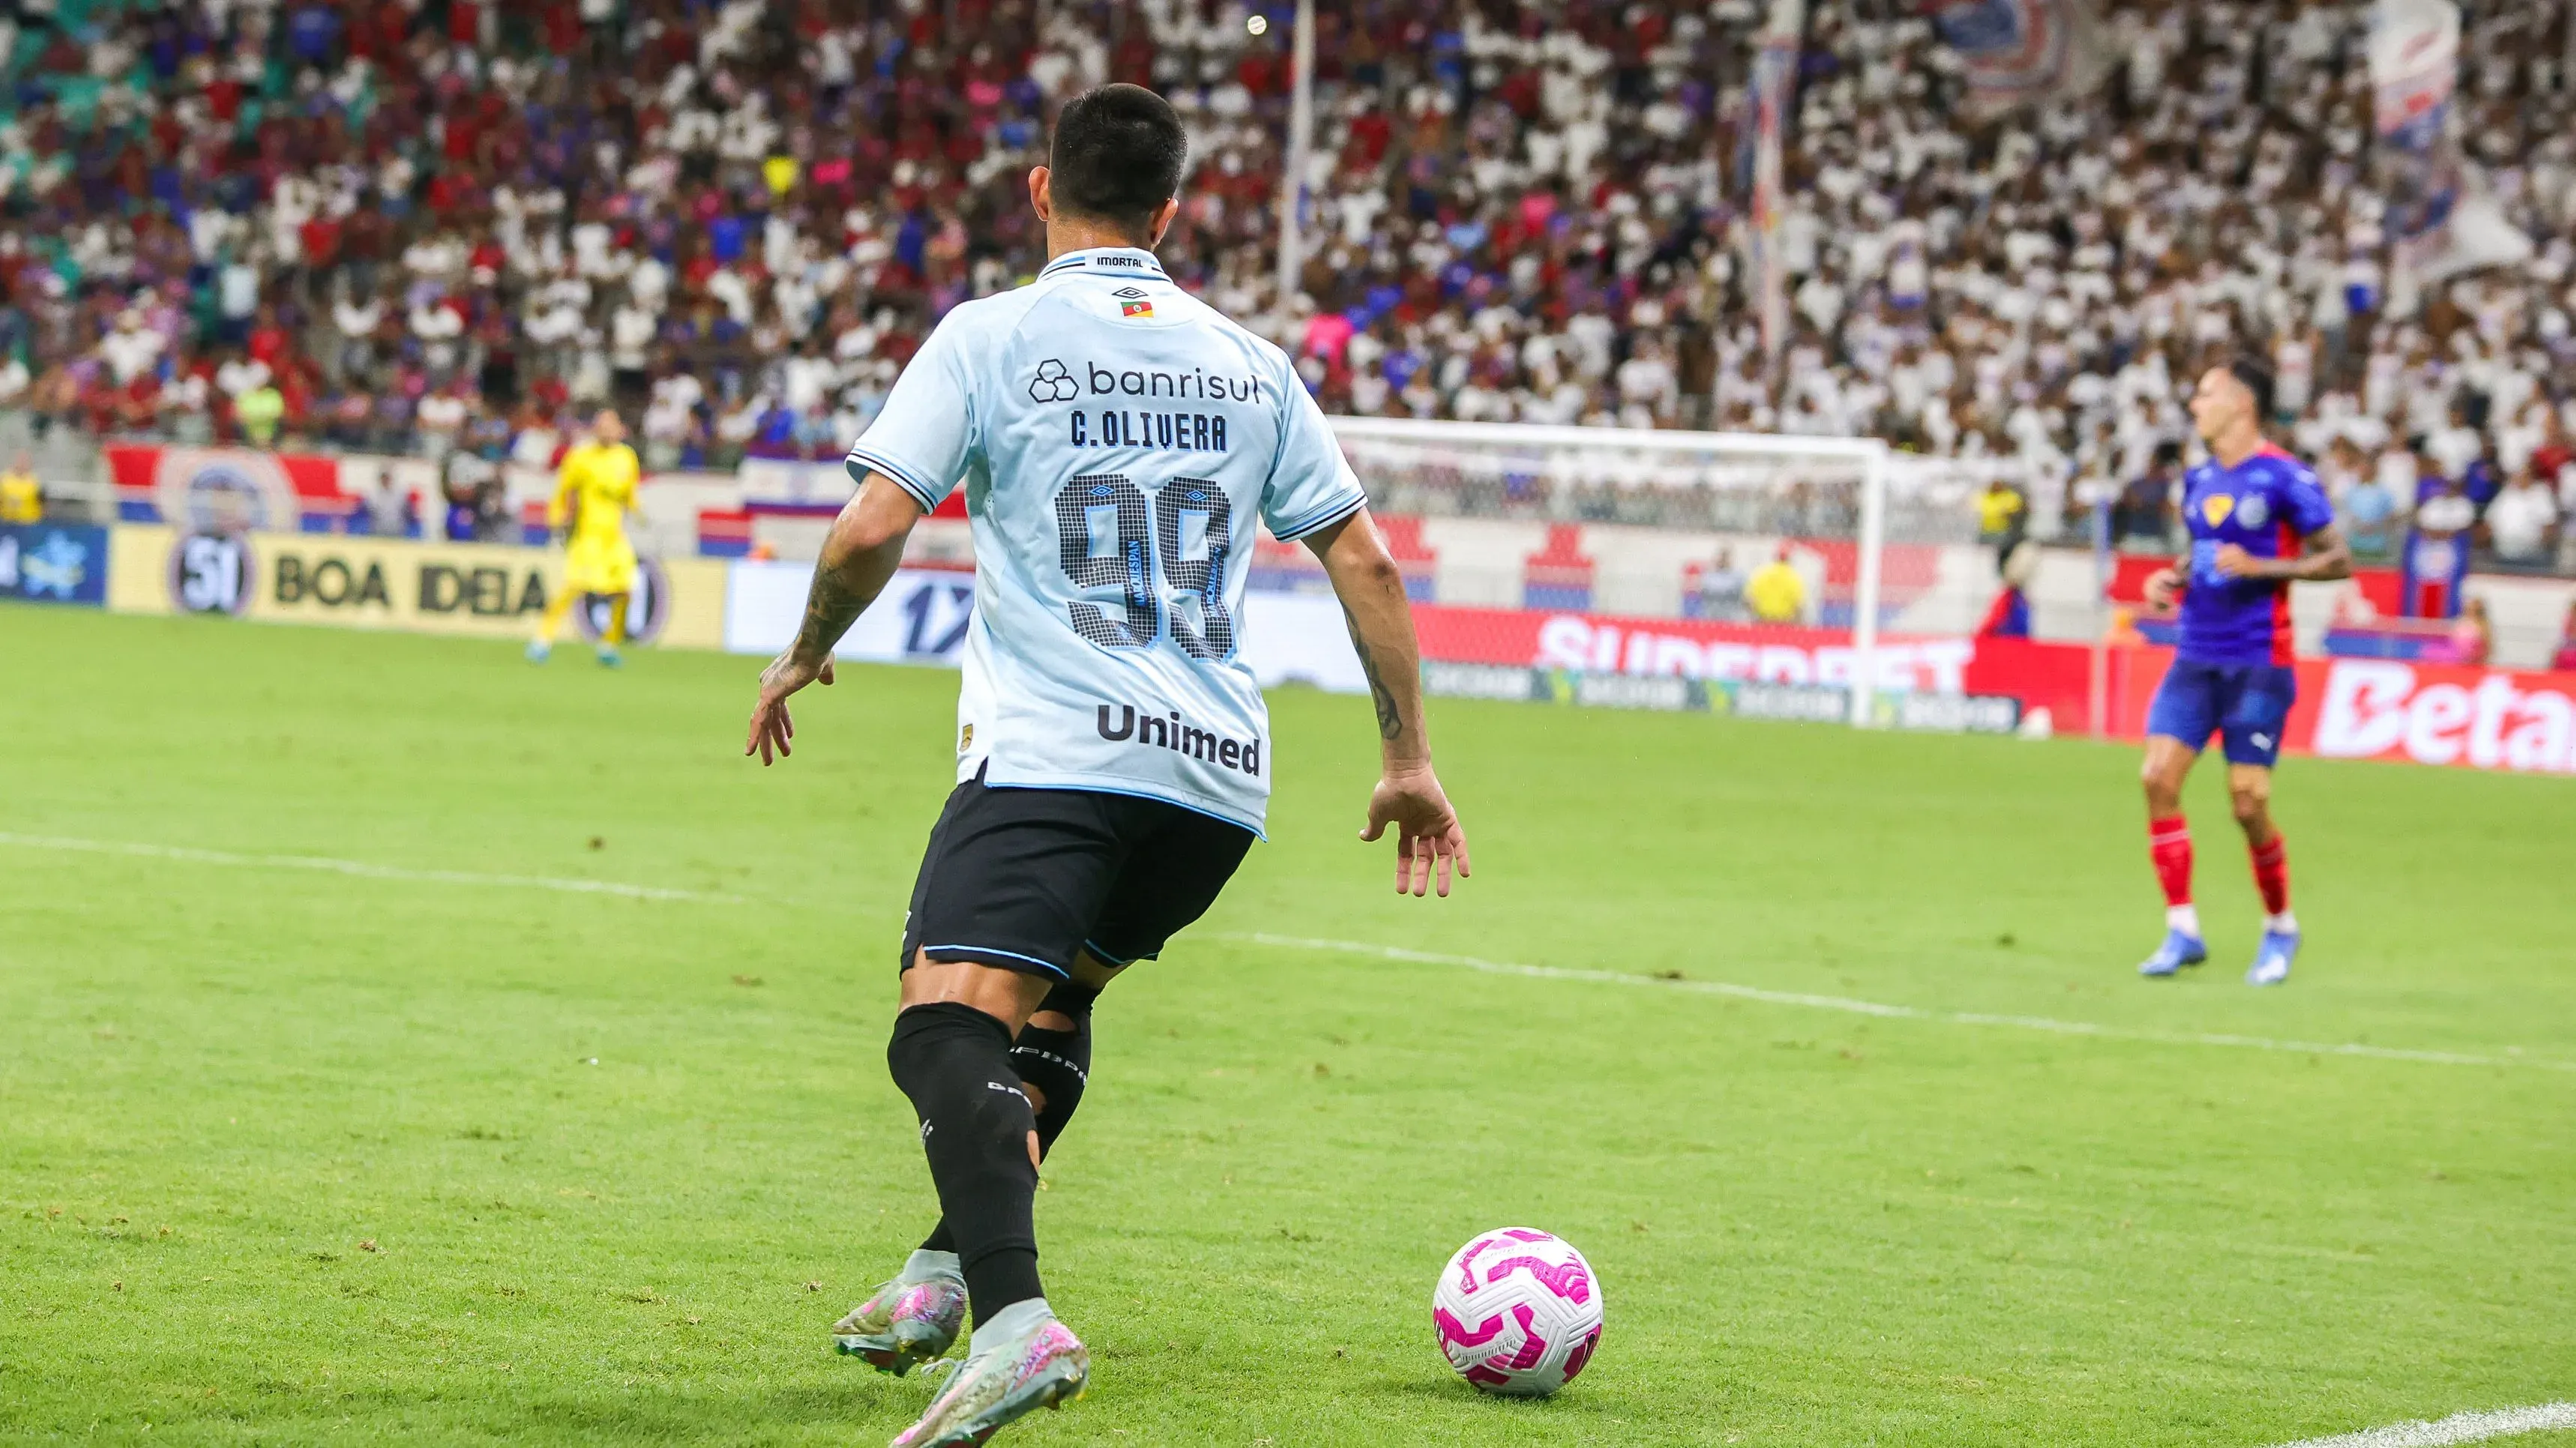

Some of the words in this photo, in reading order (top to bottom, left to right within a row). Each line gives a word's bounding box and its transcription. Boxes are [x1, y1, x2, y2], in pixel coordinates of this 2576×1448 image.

[1097, 256, 1143, 268] IMORTAL
[1088, 361, 1260, 404] banrisul
[1071, 410, 1227, 452] C.OLIVERA
[275, 555, 391, 606] BOA
[1054, 474, 1238, 665] 99
[1097, 704, 1260, 776] Unimed
